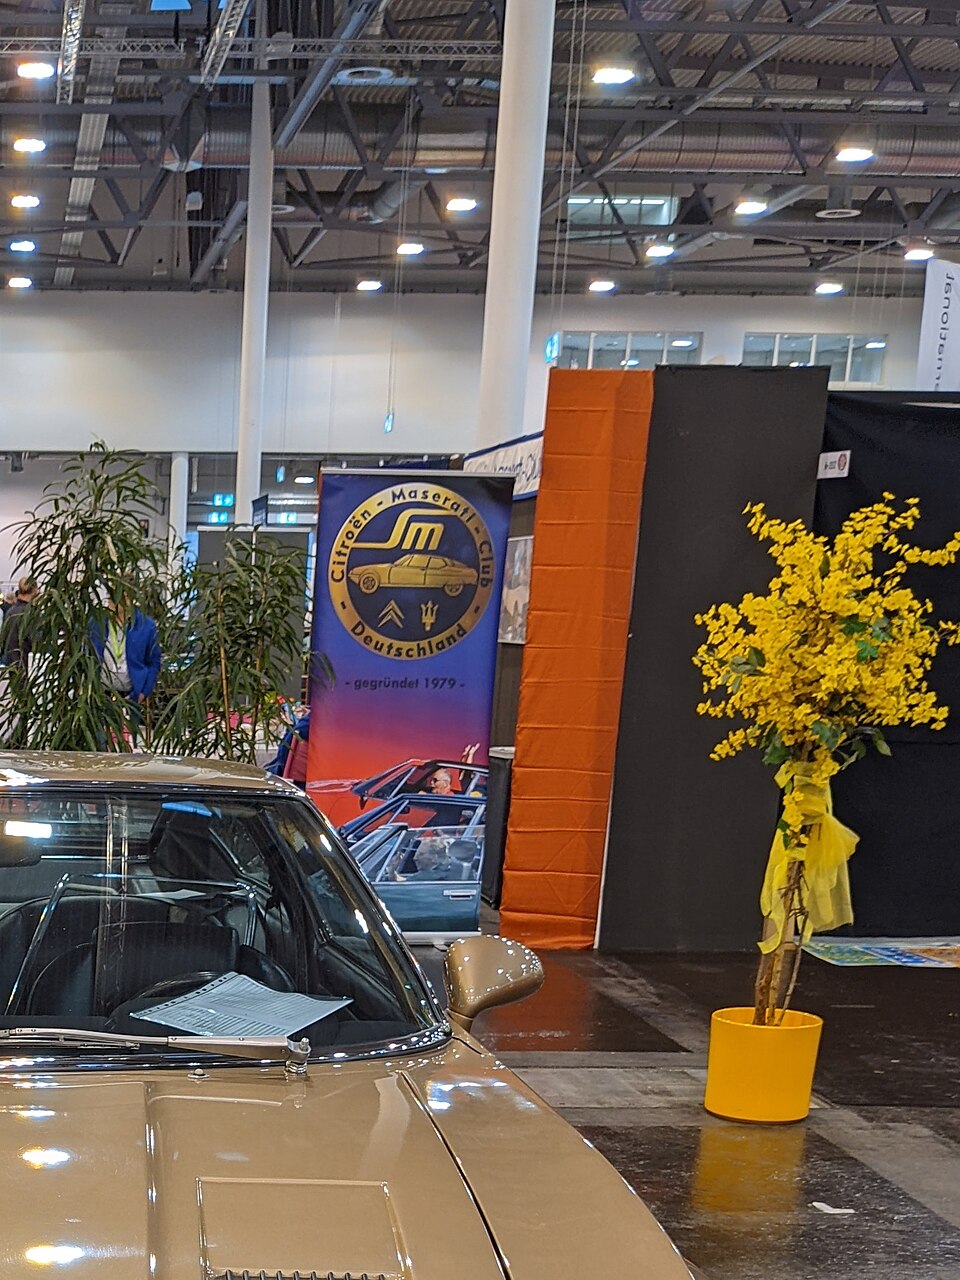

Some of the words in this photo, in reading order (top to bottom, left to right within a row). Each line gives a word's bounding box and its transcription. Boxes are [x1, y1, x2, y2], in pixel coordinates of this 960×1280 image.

[331, 510, 372, 583] Citroën
[392, 487, 476, 523] Maserati
[478, 540, 494, 588] Club
[350, 622, 468, 659] Deutschland
[354, 677, 419, 691] gegründet
[424, 677, 457, 690] 1979
